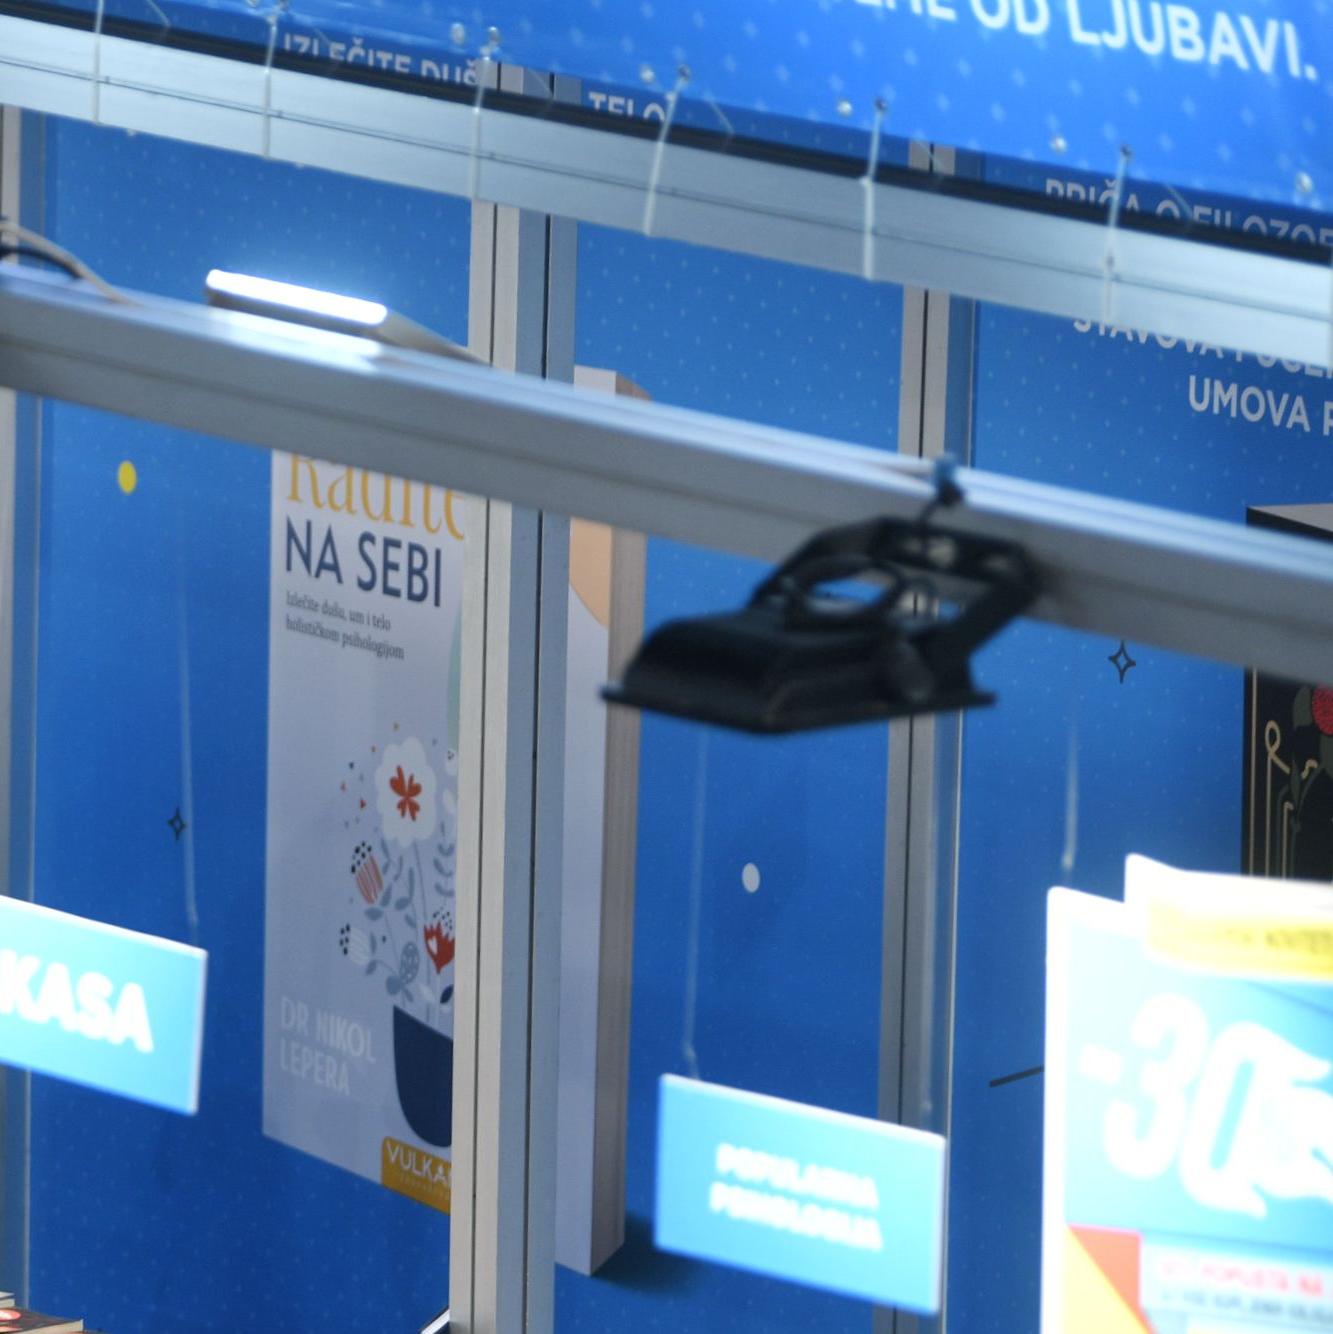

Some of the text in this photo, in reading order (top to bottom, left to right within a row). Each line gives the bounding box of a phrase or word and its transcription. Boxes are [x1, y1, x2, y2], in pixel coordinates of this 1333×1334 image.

[1065, 0, 1317, 81] LJUBAVI.
[1188, 374, 1312, 433] UMOVA
[285, 514, 442, 609] NA SEBI
[349, 609, 365, 623] um
[372, 612, 392, 632] telo
[281, 995, 377, 1064] DR NIKOL
[279, 1037, 351, 1097] LEPERA
